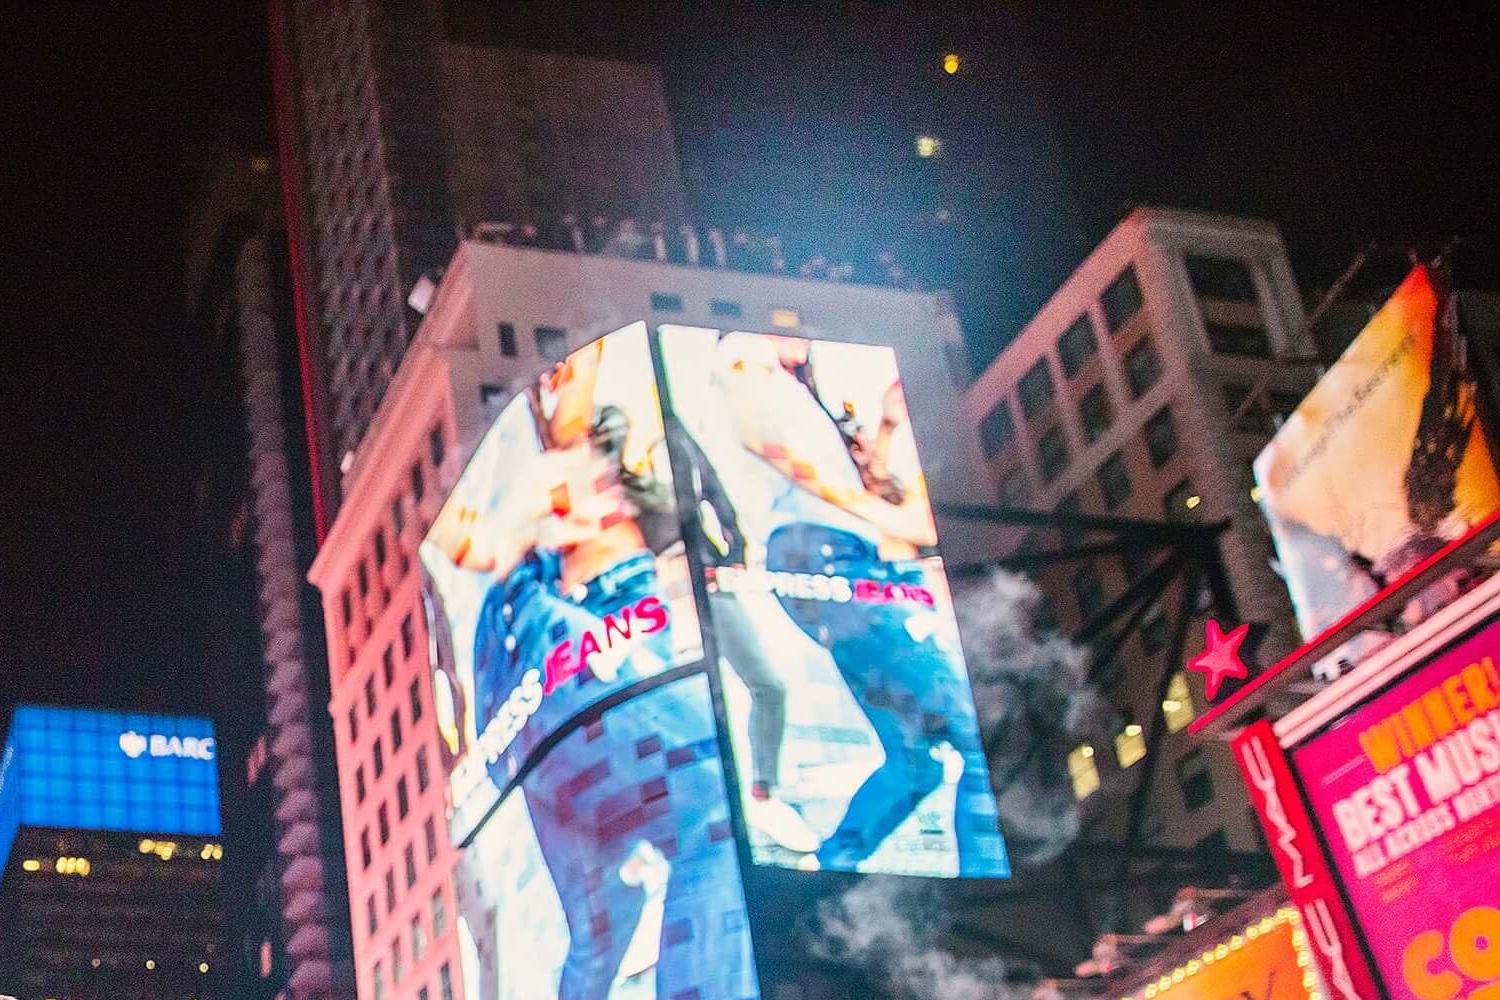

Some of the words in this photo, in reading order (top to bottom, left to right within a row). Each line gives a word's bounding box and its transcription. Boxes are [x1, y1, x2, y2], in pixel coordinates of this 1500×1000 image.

[854, 580, 934, 610] JEANS
[544, 596, 667, 696] JEANS
[150, 734, 215, 760] BARC
[1332, 764, 1420, 849] BEST
